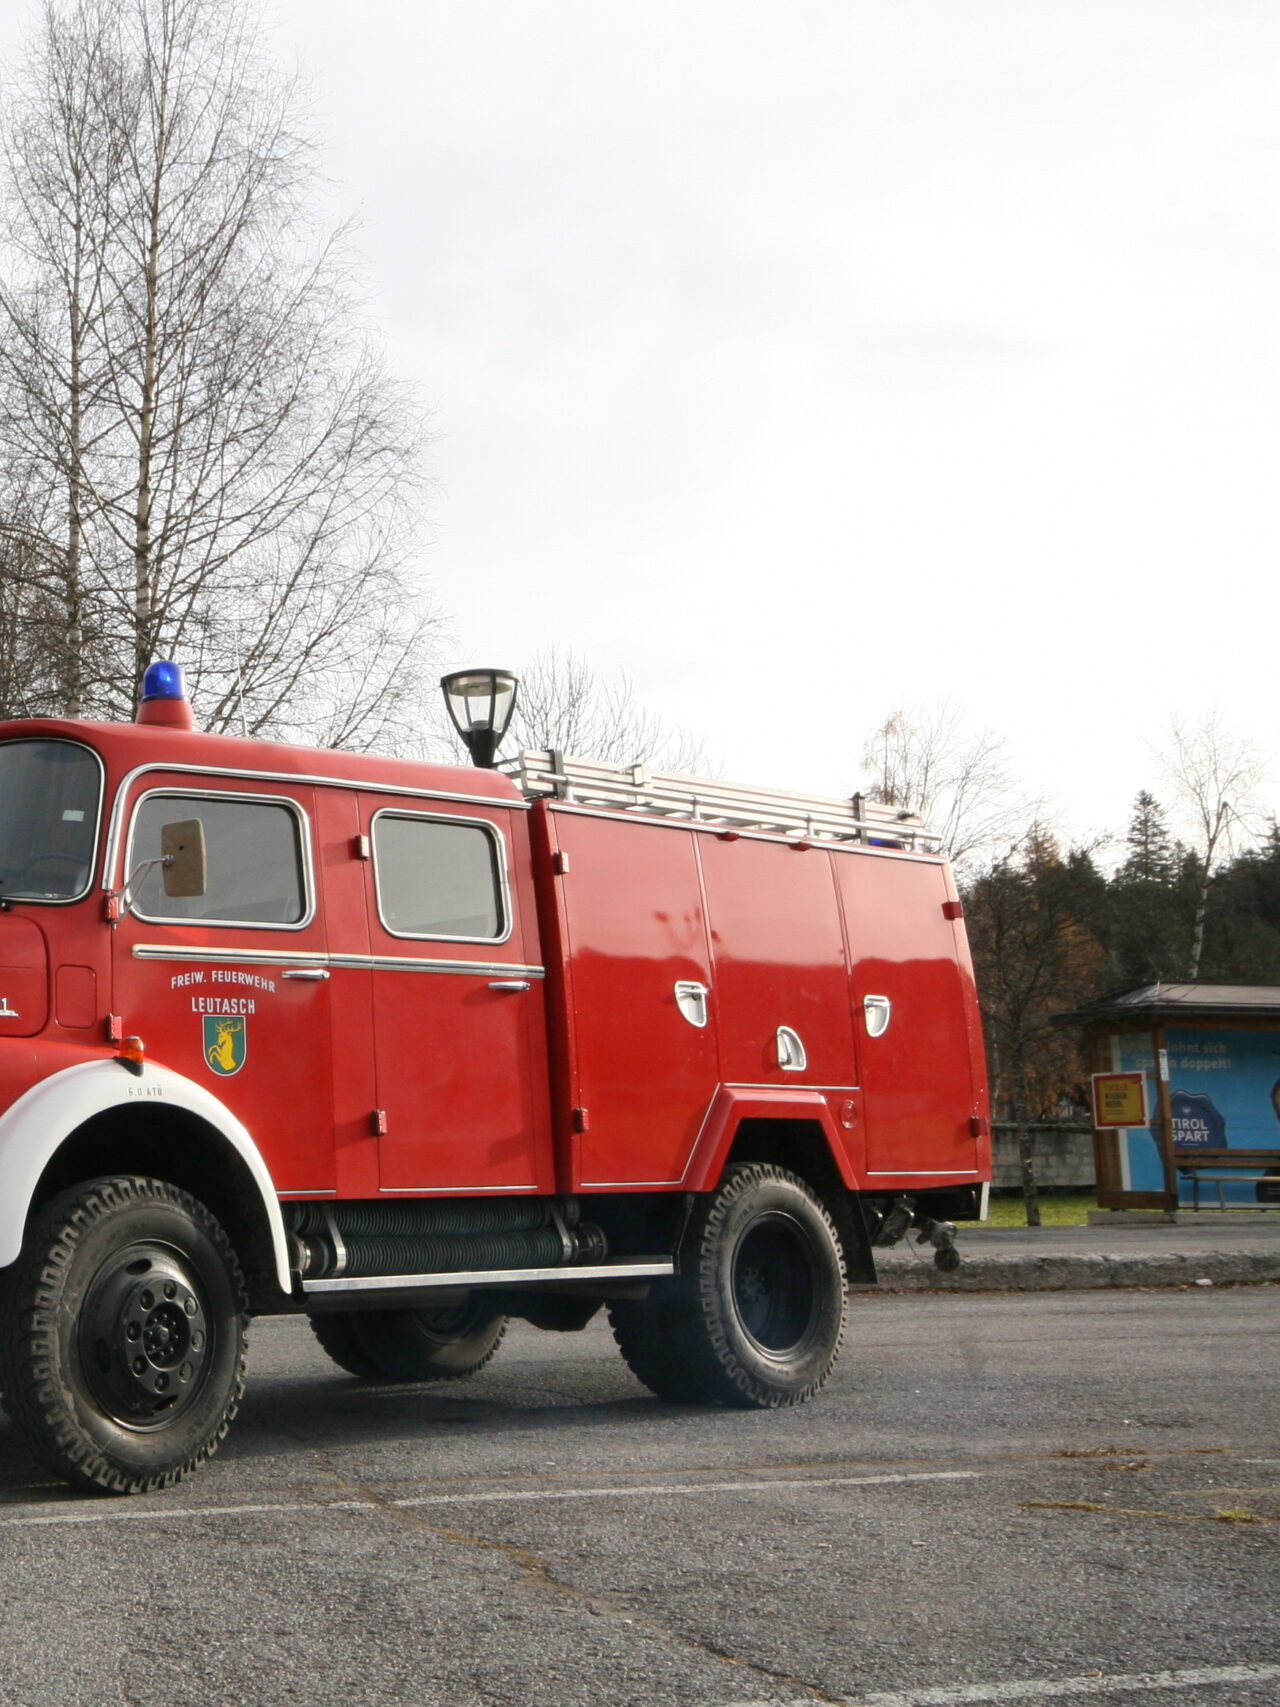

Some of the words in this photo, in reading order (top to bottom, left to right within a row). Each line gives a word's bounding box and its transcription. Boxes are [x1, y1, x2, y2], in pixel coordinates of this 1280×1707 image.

[170, 971, 207, 989] FREIW.
[211, 970, 276, 993] FEUERWEHR
[191, 996, 256, 1015] LEUTASCH
[1170, 1118, 1208, 1130] TIROL
[1171, 1130, 1210, 1142] SPART
